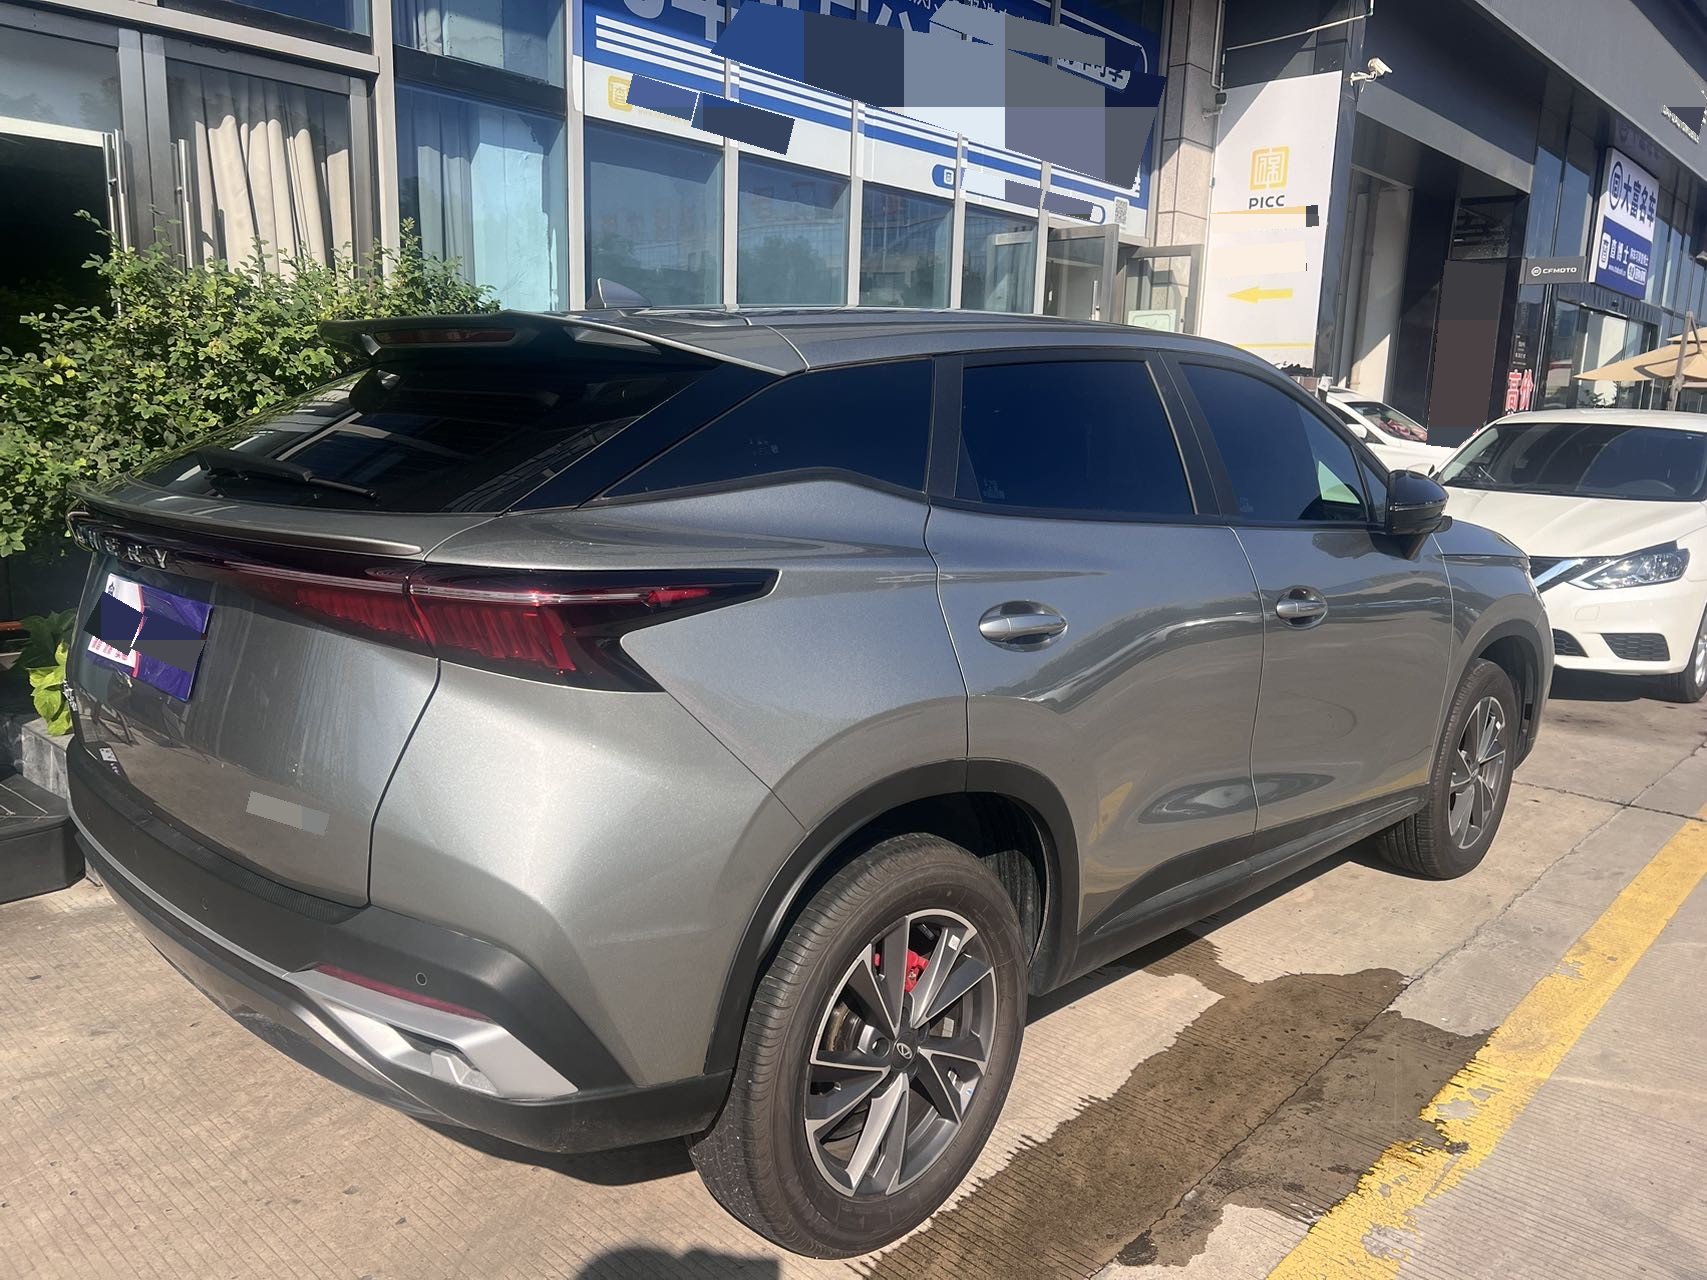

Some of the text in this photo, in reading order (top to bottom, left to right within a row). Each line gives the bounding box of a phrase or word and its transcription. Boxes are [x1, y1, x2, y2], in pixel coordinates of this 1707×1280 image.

[1249, 195, 1285, 209] PICC
[1621, 174, 1657, 227] 大富名车
[1505, 369, 1534, 411] 高价
